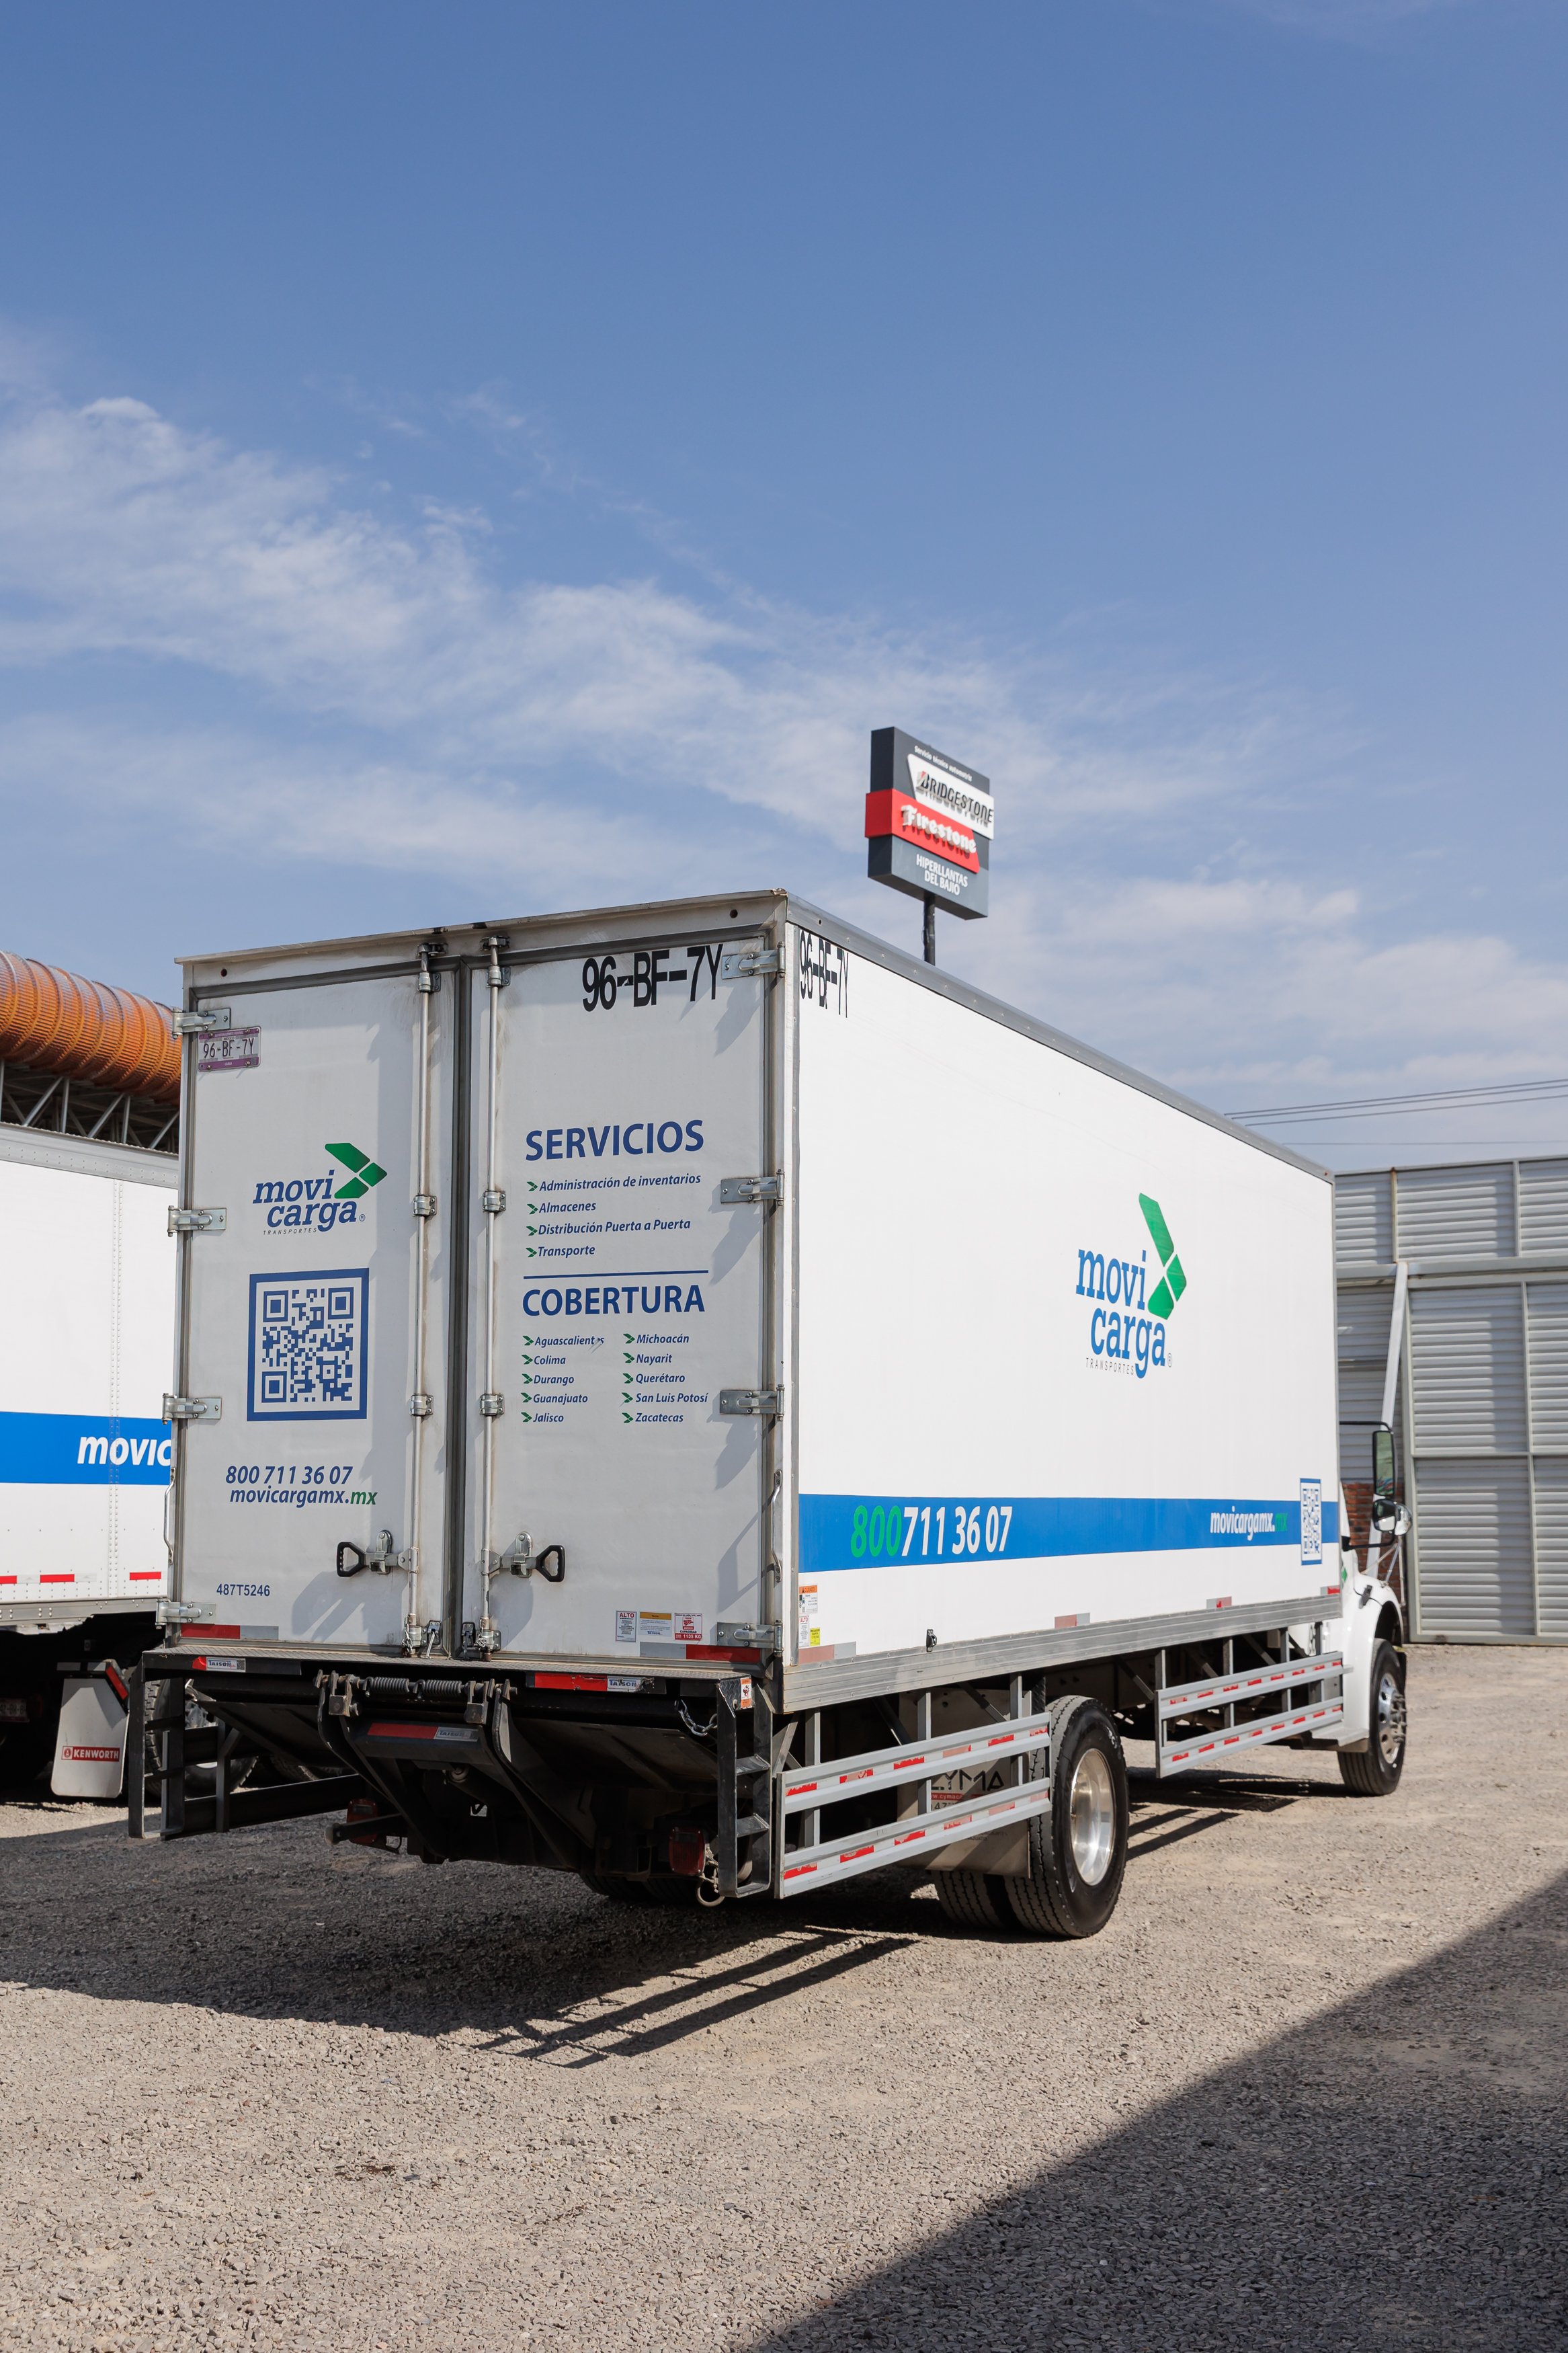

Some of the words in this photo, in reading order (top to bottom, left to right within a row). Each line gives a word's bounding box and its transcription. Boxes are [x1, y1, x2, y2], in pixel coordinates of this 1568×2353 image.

[917, 770, 993, 824] BRIDGESTONE
[901, 805, 977, 853] Firestone
[916, 854, 968, 887] HIPERLLANTAS
[924, 870, 939, 887] DEL
[582, 943, 724, 1012] 96-BF-7Y
[203, 1037, 254, 1059] 96-BF-7Y
[526, 1119, 704, 1162] SERVICIOS
[253, 1169, 335, 1204] movi
[539, 1178, 620, 1192] Administración
[622, 1176, 636, 1187] de
[638, 1173, 701, 1187] inventarios
[267, 1201, 357, 1232] carga
[538, 1202, 597, 1213] Almacenes
[263, 1227, 317, 1236] TRANSPORTES
[538, 1222, 603, 1235] Distribución
[605, 1221, 642, 1232] Puerta
[643, 1222, 651, 1230] a
[653, 1219, 691, 1230] Puerta
[538, 1245, 595, 1258] Transporte
[1075, 1248, 1147, 1310] movi
[522, 1285, 706, 1316] COBERTURA
[636, 1334, 690, 1345] Michoacán
[1091, 1308, 1166, 1379] carga
[534, 1355, 566, 1365] Colima
[636, 1353, 673, 1366] Nayarit
[1085, 1357, 1134, 1375] TRANSPORTES
[533, 1375, 575, 1386] Durango
[635, 1373, 686, 1385] Querétaro
[533, 1394, 588, 1406] Guanajuato
[635, 1394, 655, 1403] San
[655, 1393, 675, 1403] Luis
[677, 1392, 709, 1403] Potosí
[533, 1413, 564, 1423] Jalisco
[635, 1413, 684, 1423] Zacatecas
[225, 1466, 260, 1484] 800
[263, 1466, 297, 1484] 711
[302, 1466, 325, 1484] 36
[329, 1466, 354, 1484] 07
[230, 1484, 378, 1509] movicargamx.mx
[850, 1505, 903, 1558] 800
[901, 1507, 946, 1557] 711
[952, 1505, 981, 1555] 36
[985, 1505, 1013, 1553] 07
[1210, 1505, 1288, 1541] movicargamx.mx
[216, 1583, 271, 1597] 487T5246
[609, 1679, 636, 1687] TAISON
[73, 1749, 119, 1759] KENWORTH
[931, 1769, 1004, 1792] YMA
